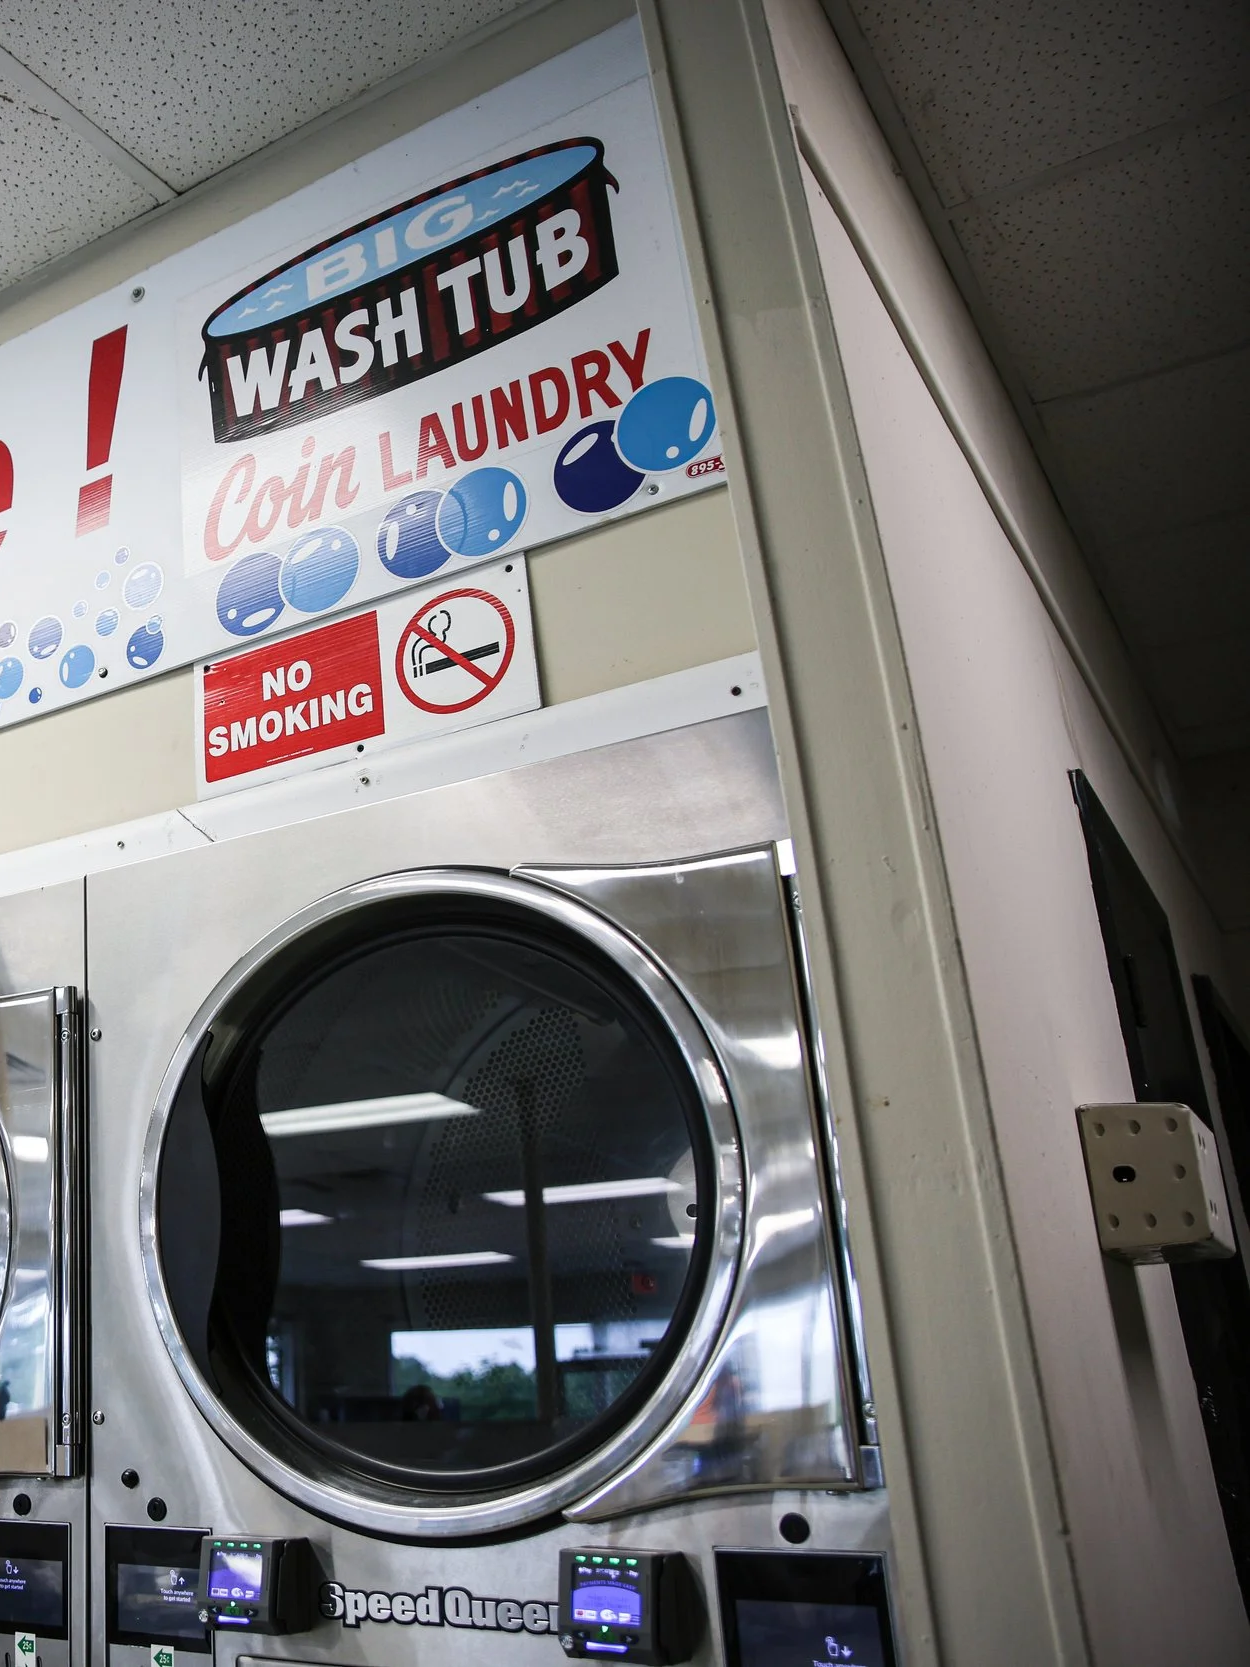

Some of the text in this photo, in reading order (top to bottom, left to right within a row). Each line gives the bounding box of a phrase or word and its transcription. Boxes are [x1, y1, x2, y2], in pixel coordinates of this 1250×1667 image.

[305, 194, 475, 301] BIG
[225, 208, 590, 418] WASH TUB
[203, 328, 652, 562] Coin LAUNDRY
[208, 683, 374, 758] SMOKING
[261, 660, 313, 701] NO
[319, 1581, 444, 1628] Speed
